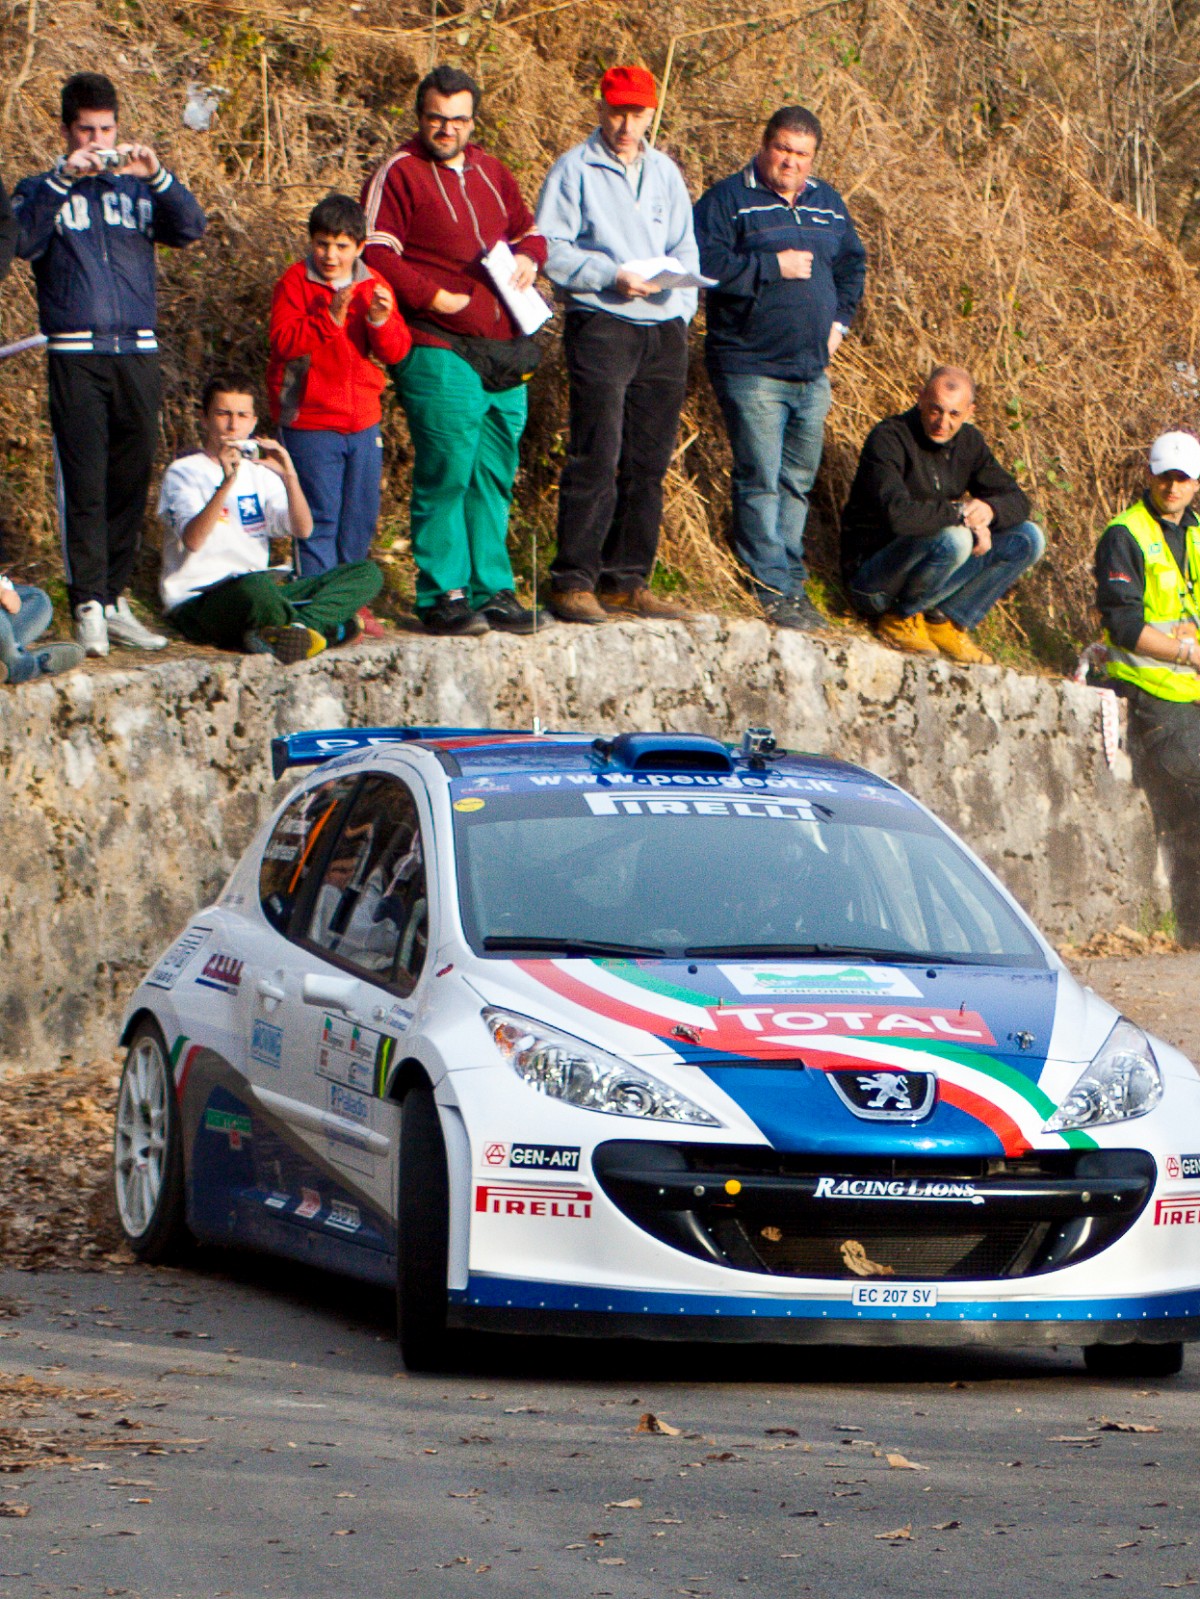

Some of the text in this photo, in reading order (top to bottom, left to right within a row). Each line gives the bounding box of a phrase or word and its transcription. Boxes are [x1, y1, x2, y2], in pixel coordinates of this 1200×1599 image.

[582, 791, 817, 821] PIRELLI
[716, 1007, 983, 1037] TOTAL
[510, 1148, 579, 1167] GEN-ART
[813, 1177, 976, 1199] RACING LIONS
[475, 1185, 593, 1219] PIRELLI
[858, 1288, 932, 1304] EC 207 SV
